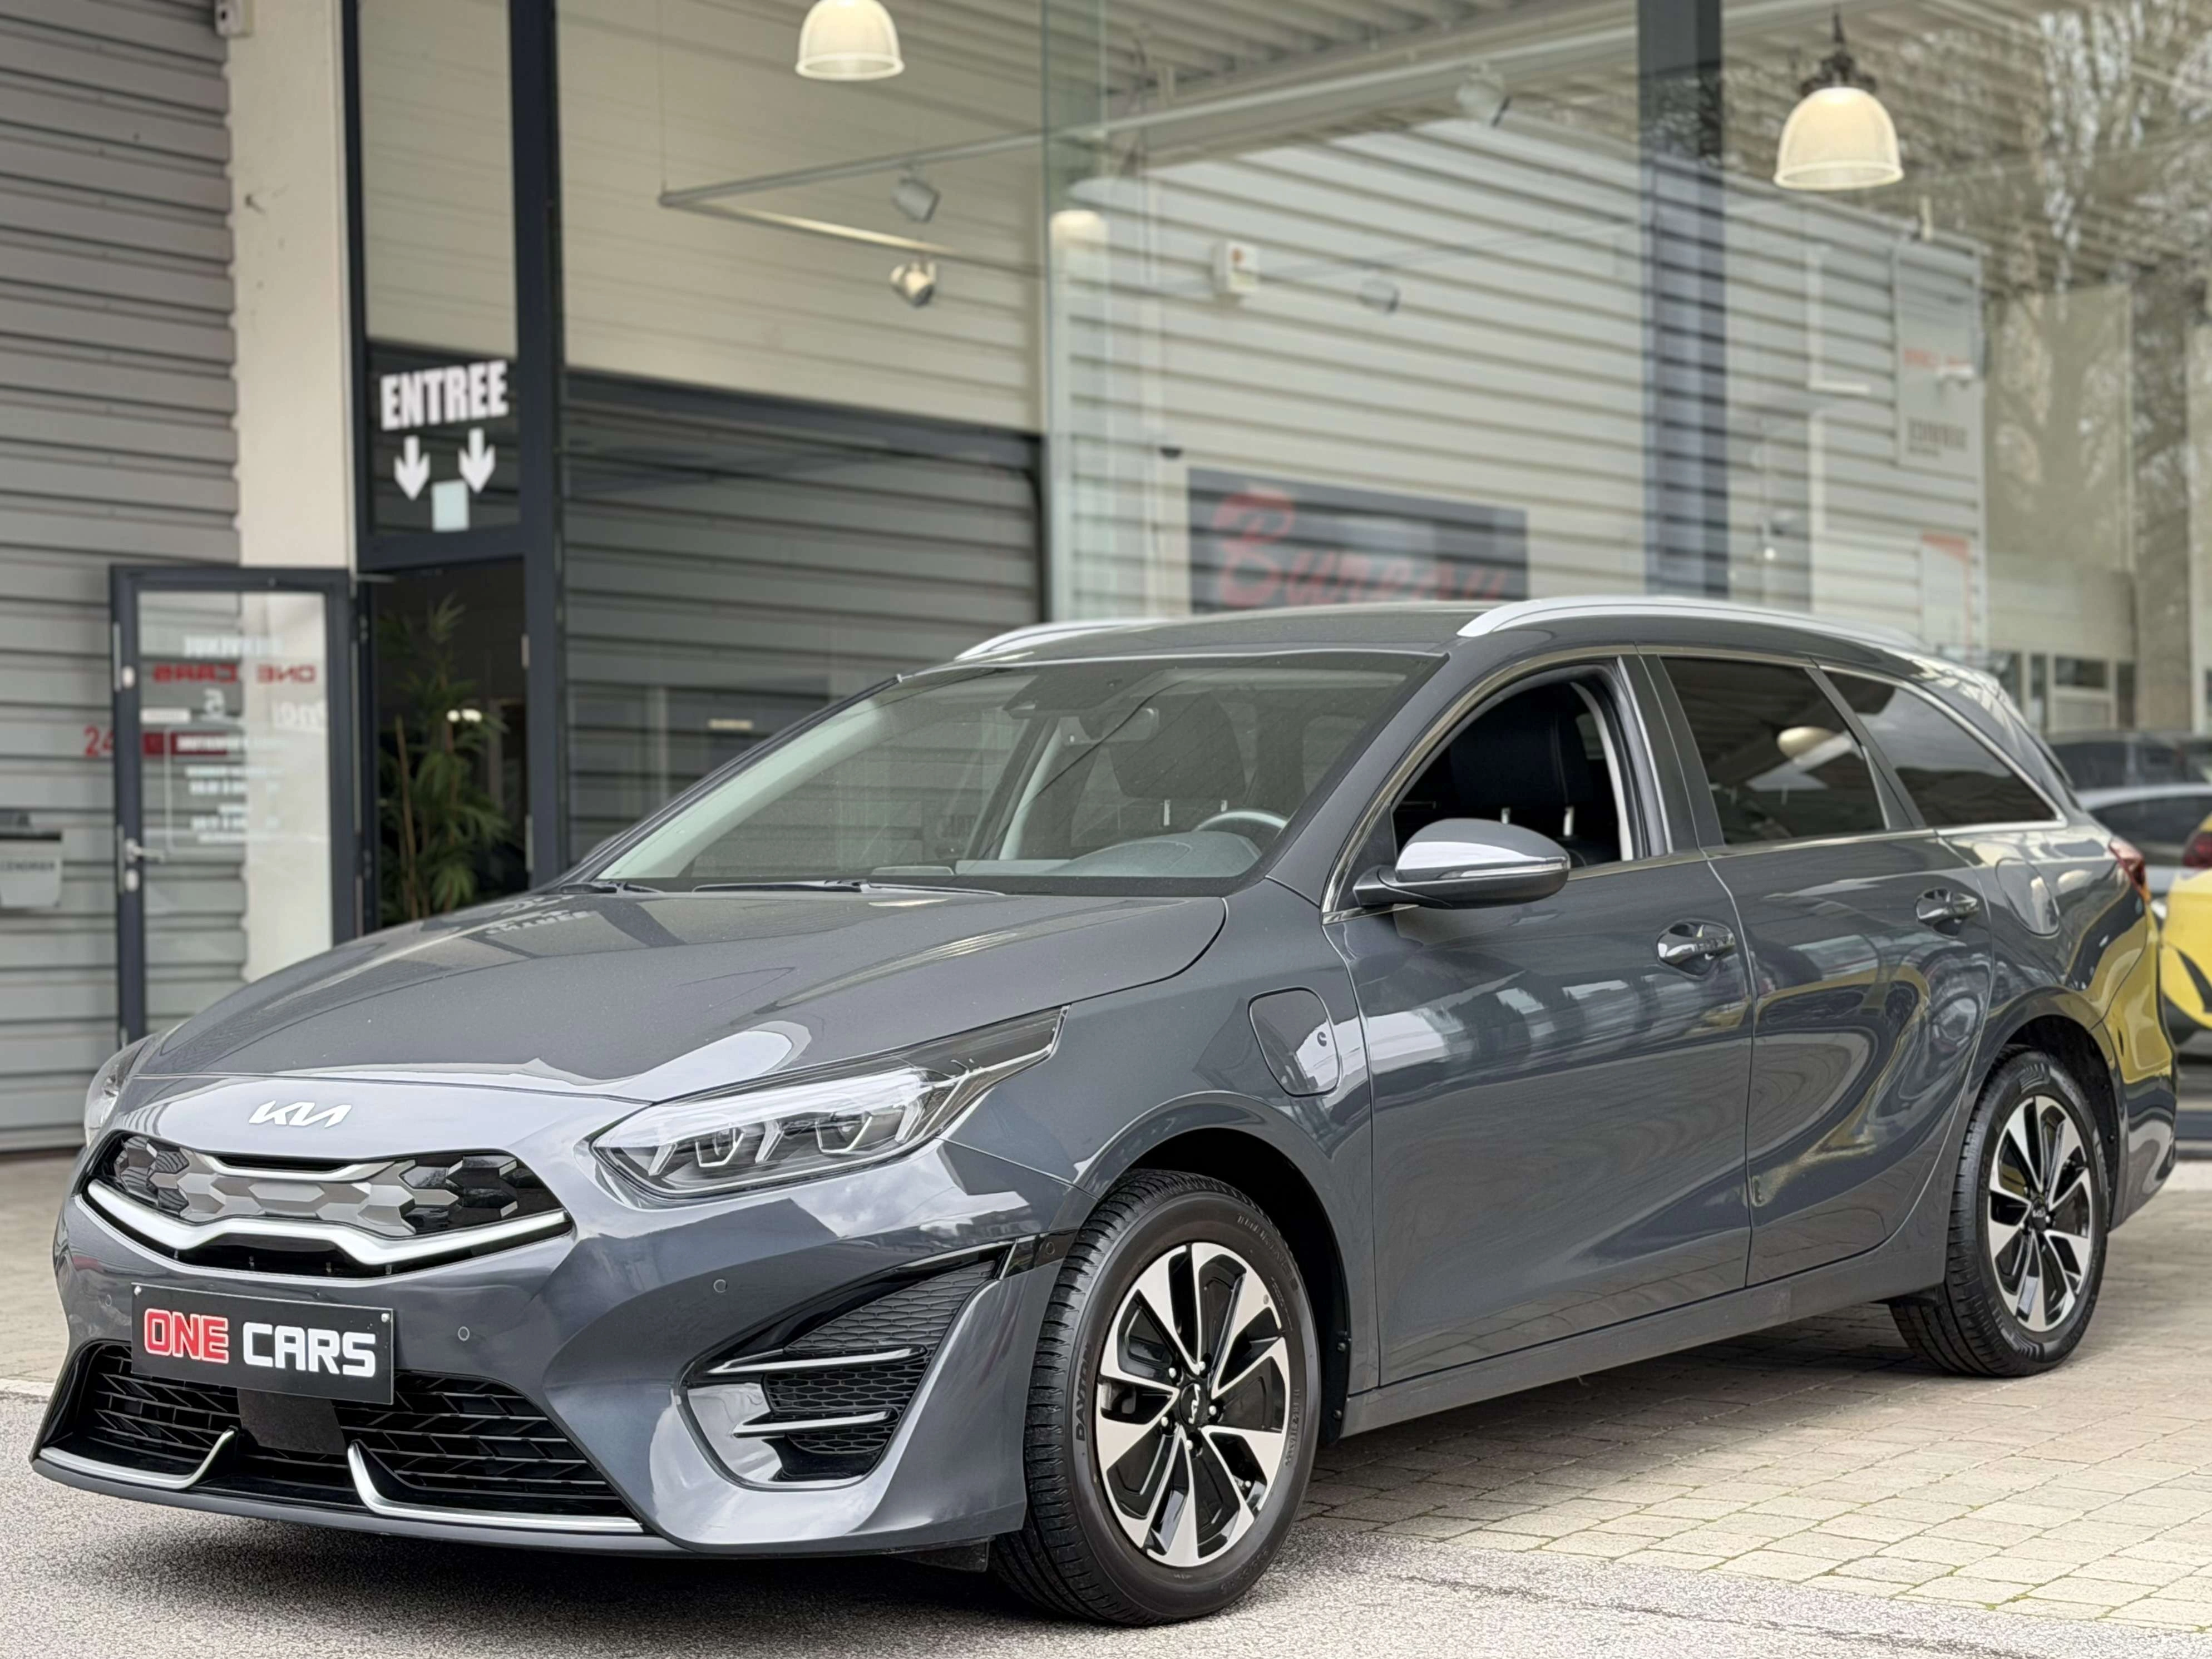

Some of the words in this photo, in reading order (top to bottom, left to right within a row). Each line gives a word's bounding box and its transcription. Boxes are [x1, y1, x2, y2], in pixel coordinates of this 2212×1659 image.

[381, 360, 508, 430] ENTREE
[249, 1099, 352, 1128] KIA
[144, 1308, 229, 1364] ONE
[243, 1321, 376, 1378] CARS
